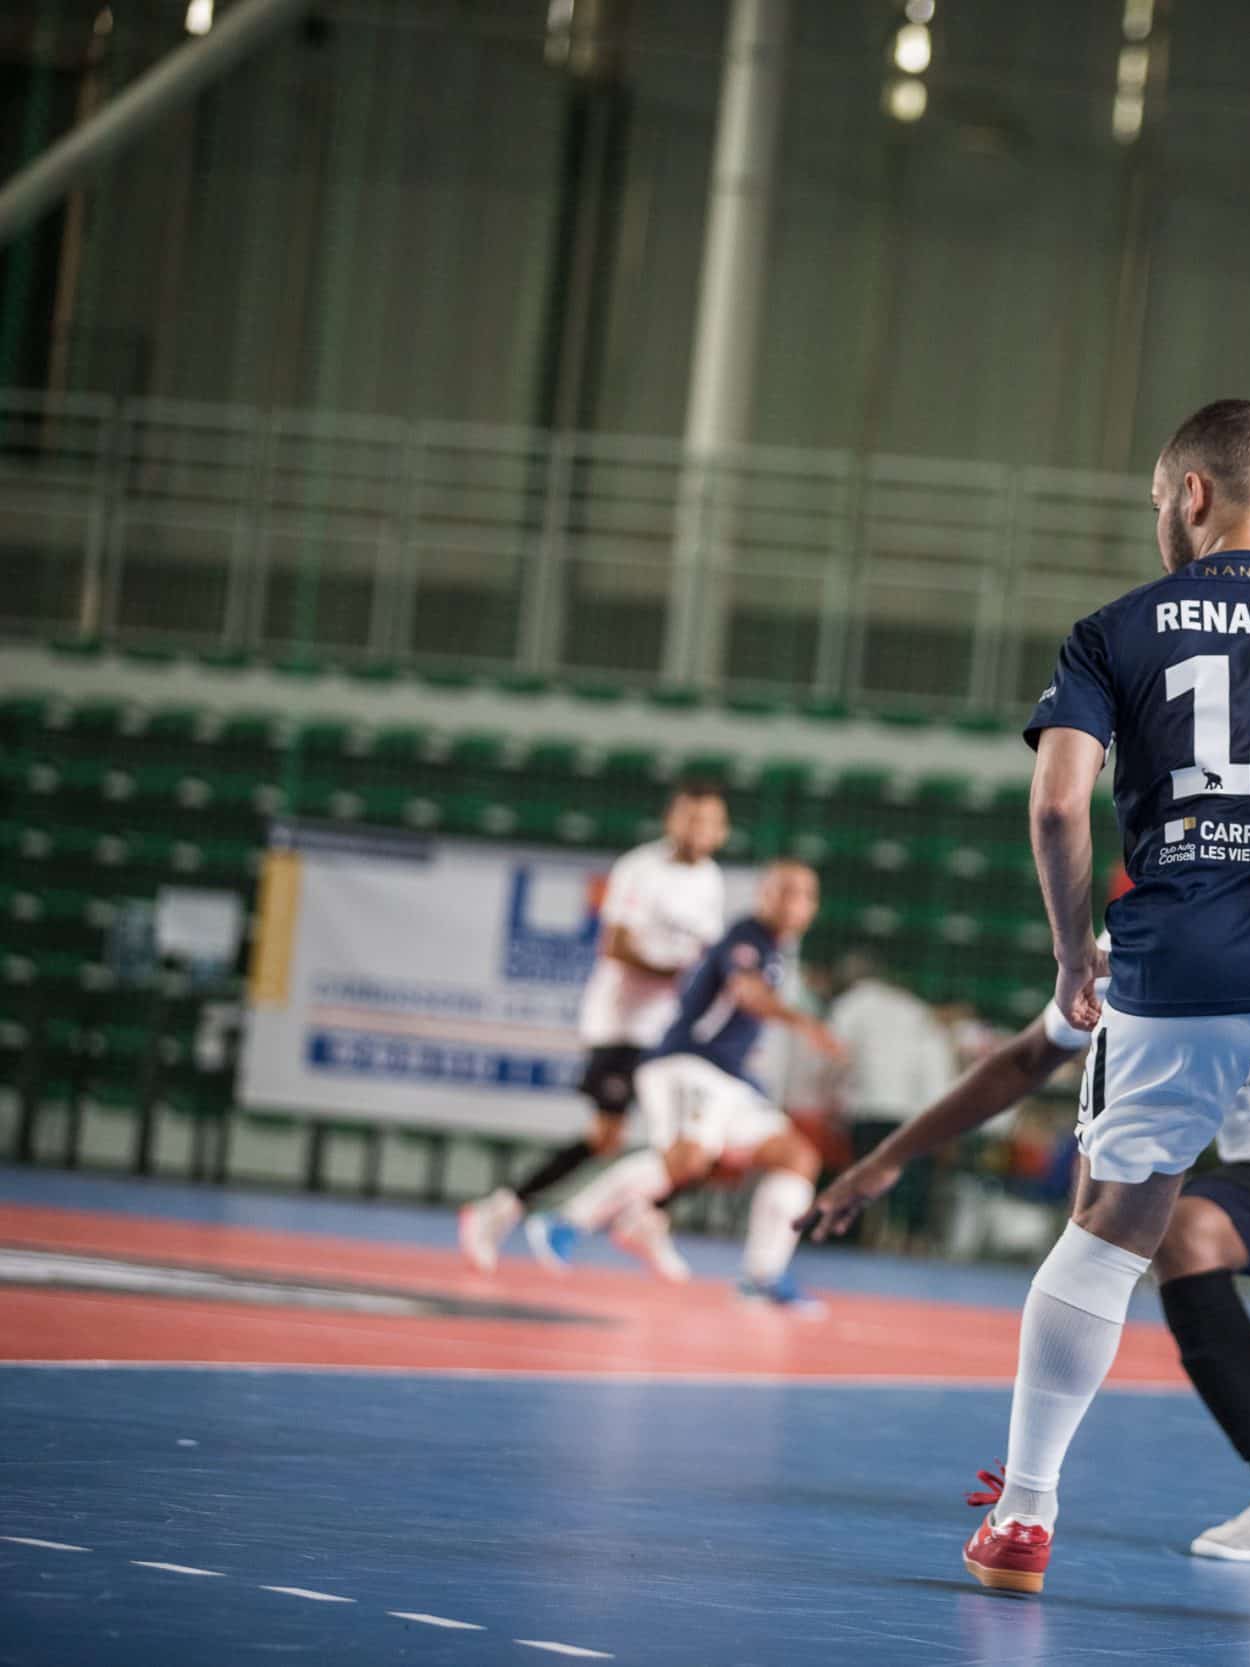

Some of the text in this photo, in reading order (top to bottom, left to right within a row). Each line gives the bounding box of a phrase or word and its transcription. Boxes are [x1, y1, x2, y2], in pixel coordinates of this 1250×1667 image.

[1177, 843, 1196, 852] Auto
[1199, 845, 1226, 860] LES
[1158, 851, 1196, 866] Conseil
